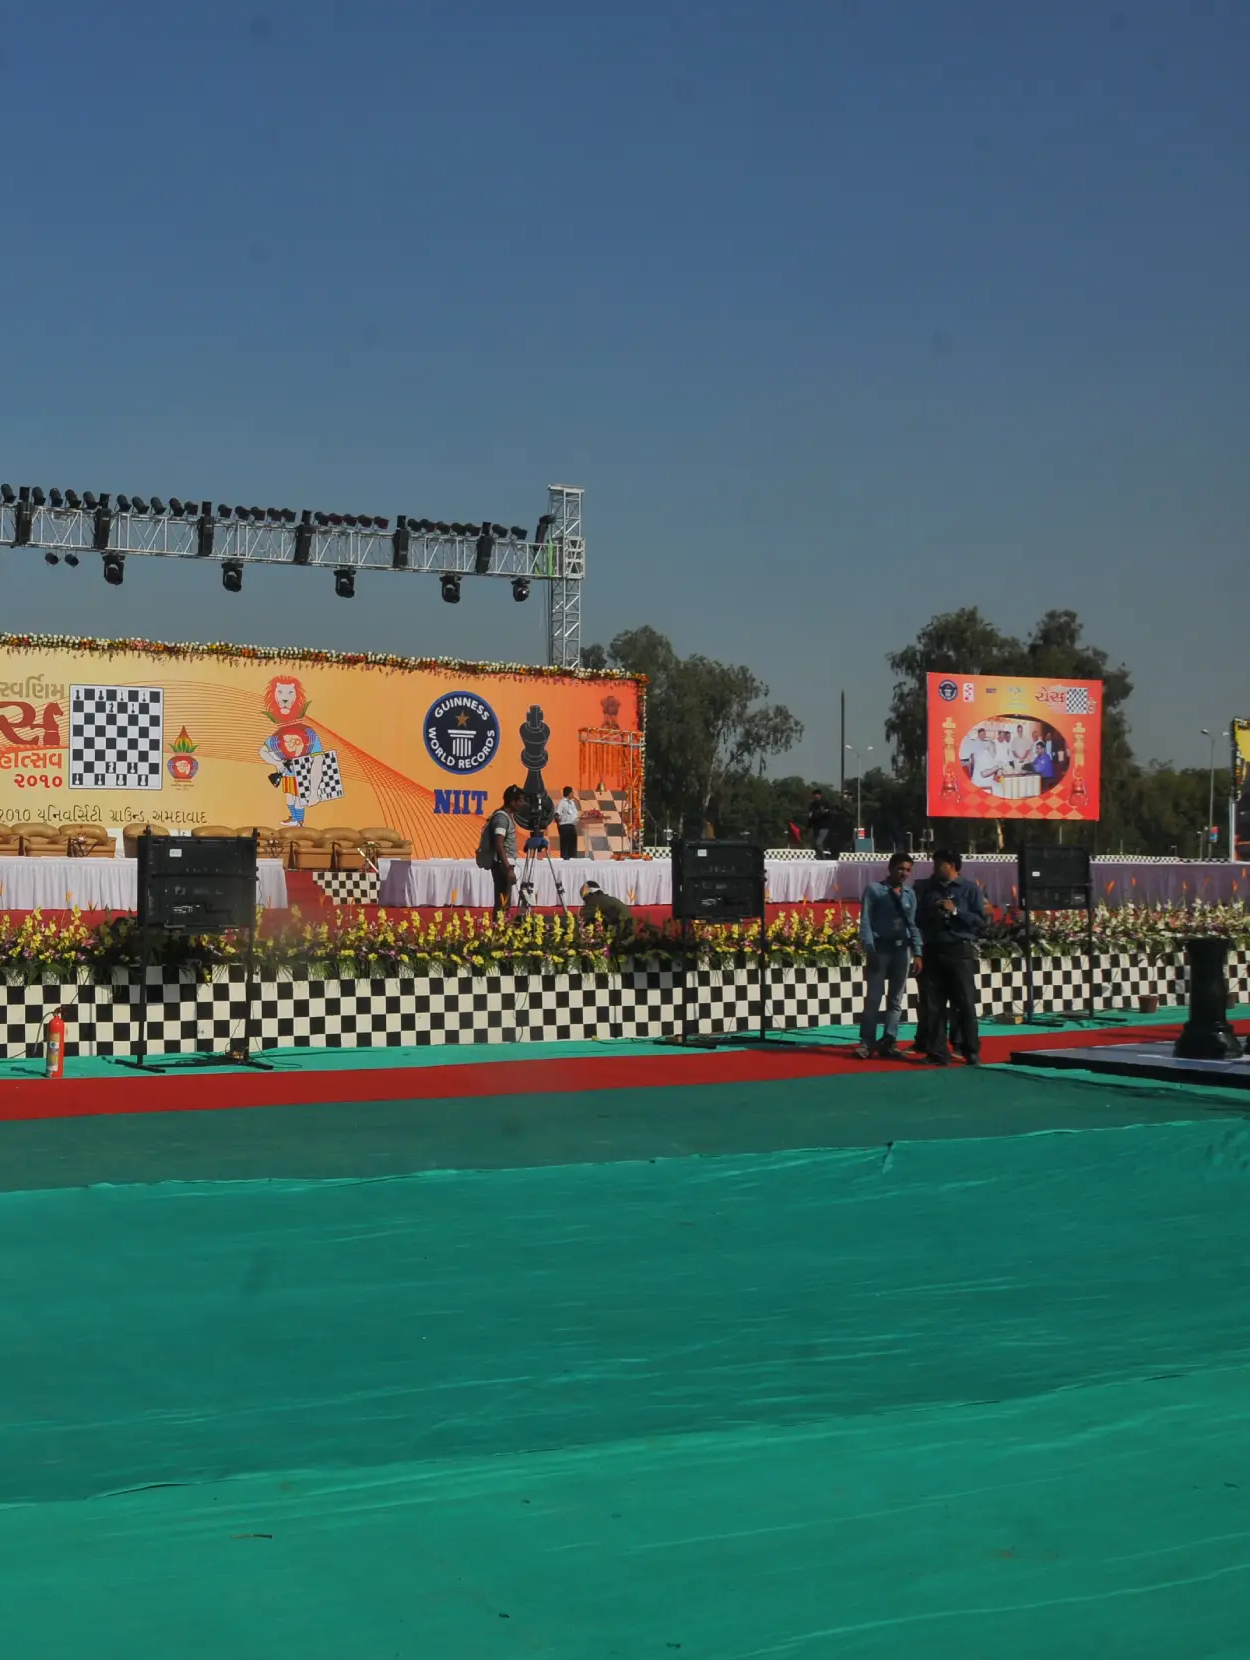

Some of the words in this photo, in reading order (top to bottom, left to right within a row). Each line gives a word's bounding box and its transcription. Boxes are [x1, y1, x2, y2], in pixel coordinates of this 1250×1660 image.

[434, 697, 490, 720] GUINNESS
[429, 727, 455, 766] WORLD
[458, 730, 495, 768] RECORDS
[14, 773, 62, 788] ૨૦૧૦
[434, 789, 488, 815] NIIT
[152, 810, 208, 823] અમદાવાદ
